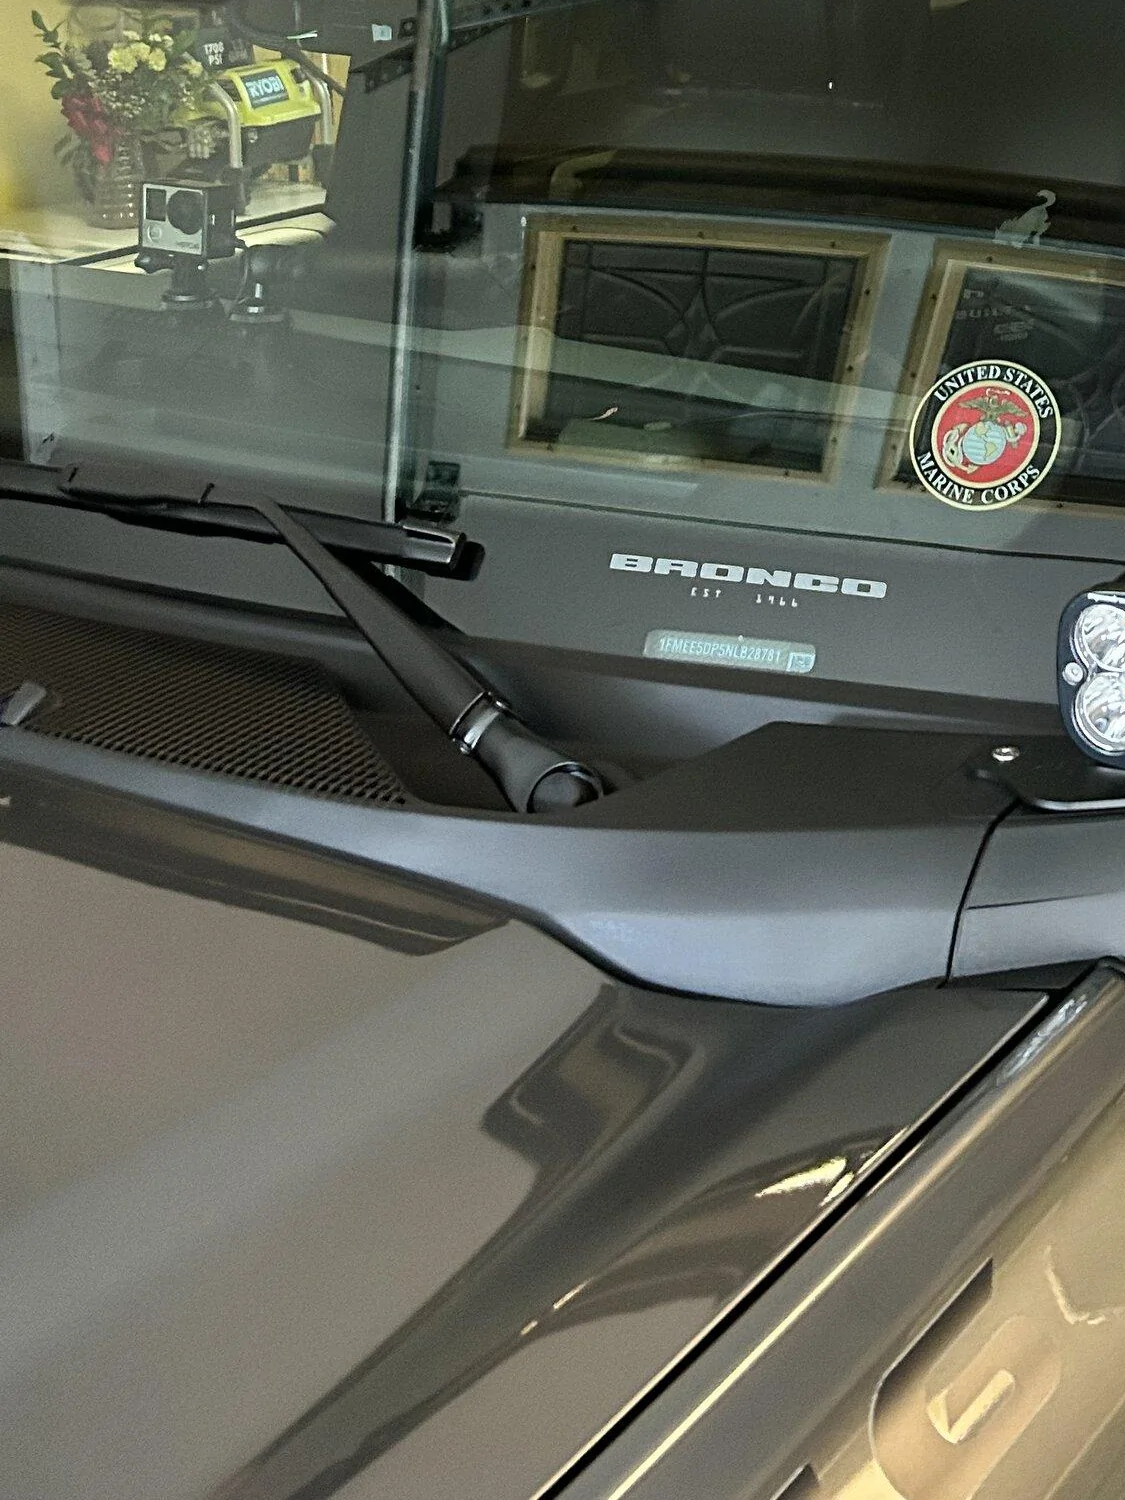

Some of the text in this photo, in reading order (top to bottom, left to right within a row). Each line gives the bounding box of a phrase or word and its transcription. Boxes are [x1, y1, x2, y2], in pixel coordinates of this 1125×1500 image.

[245, 75, 285, 98] RYOBI
[933, 365, 1053, 419] UNITED STATES
[917, 451, 1041, 504] MARINE CORPS
[609, 553, 887, 598] BRONCO
